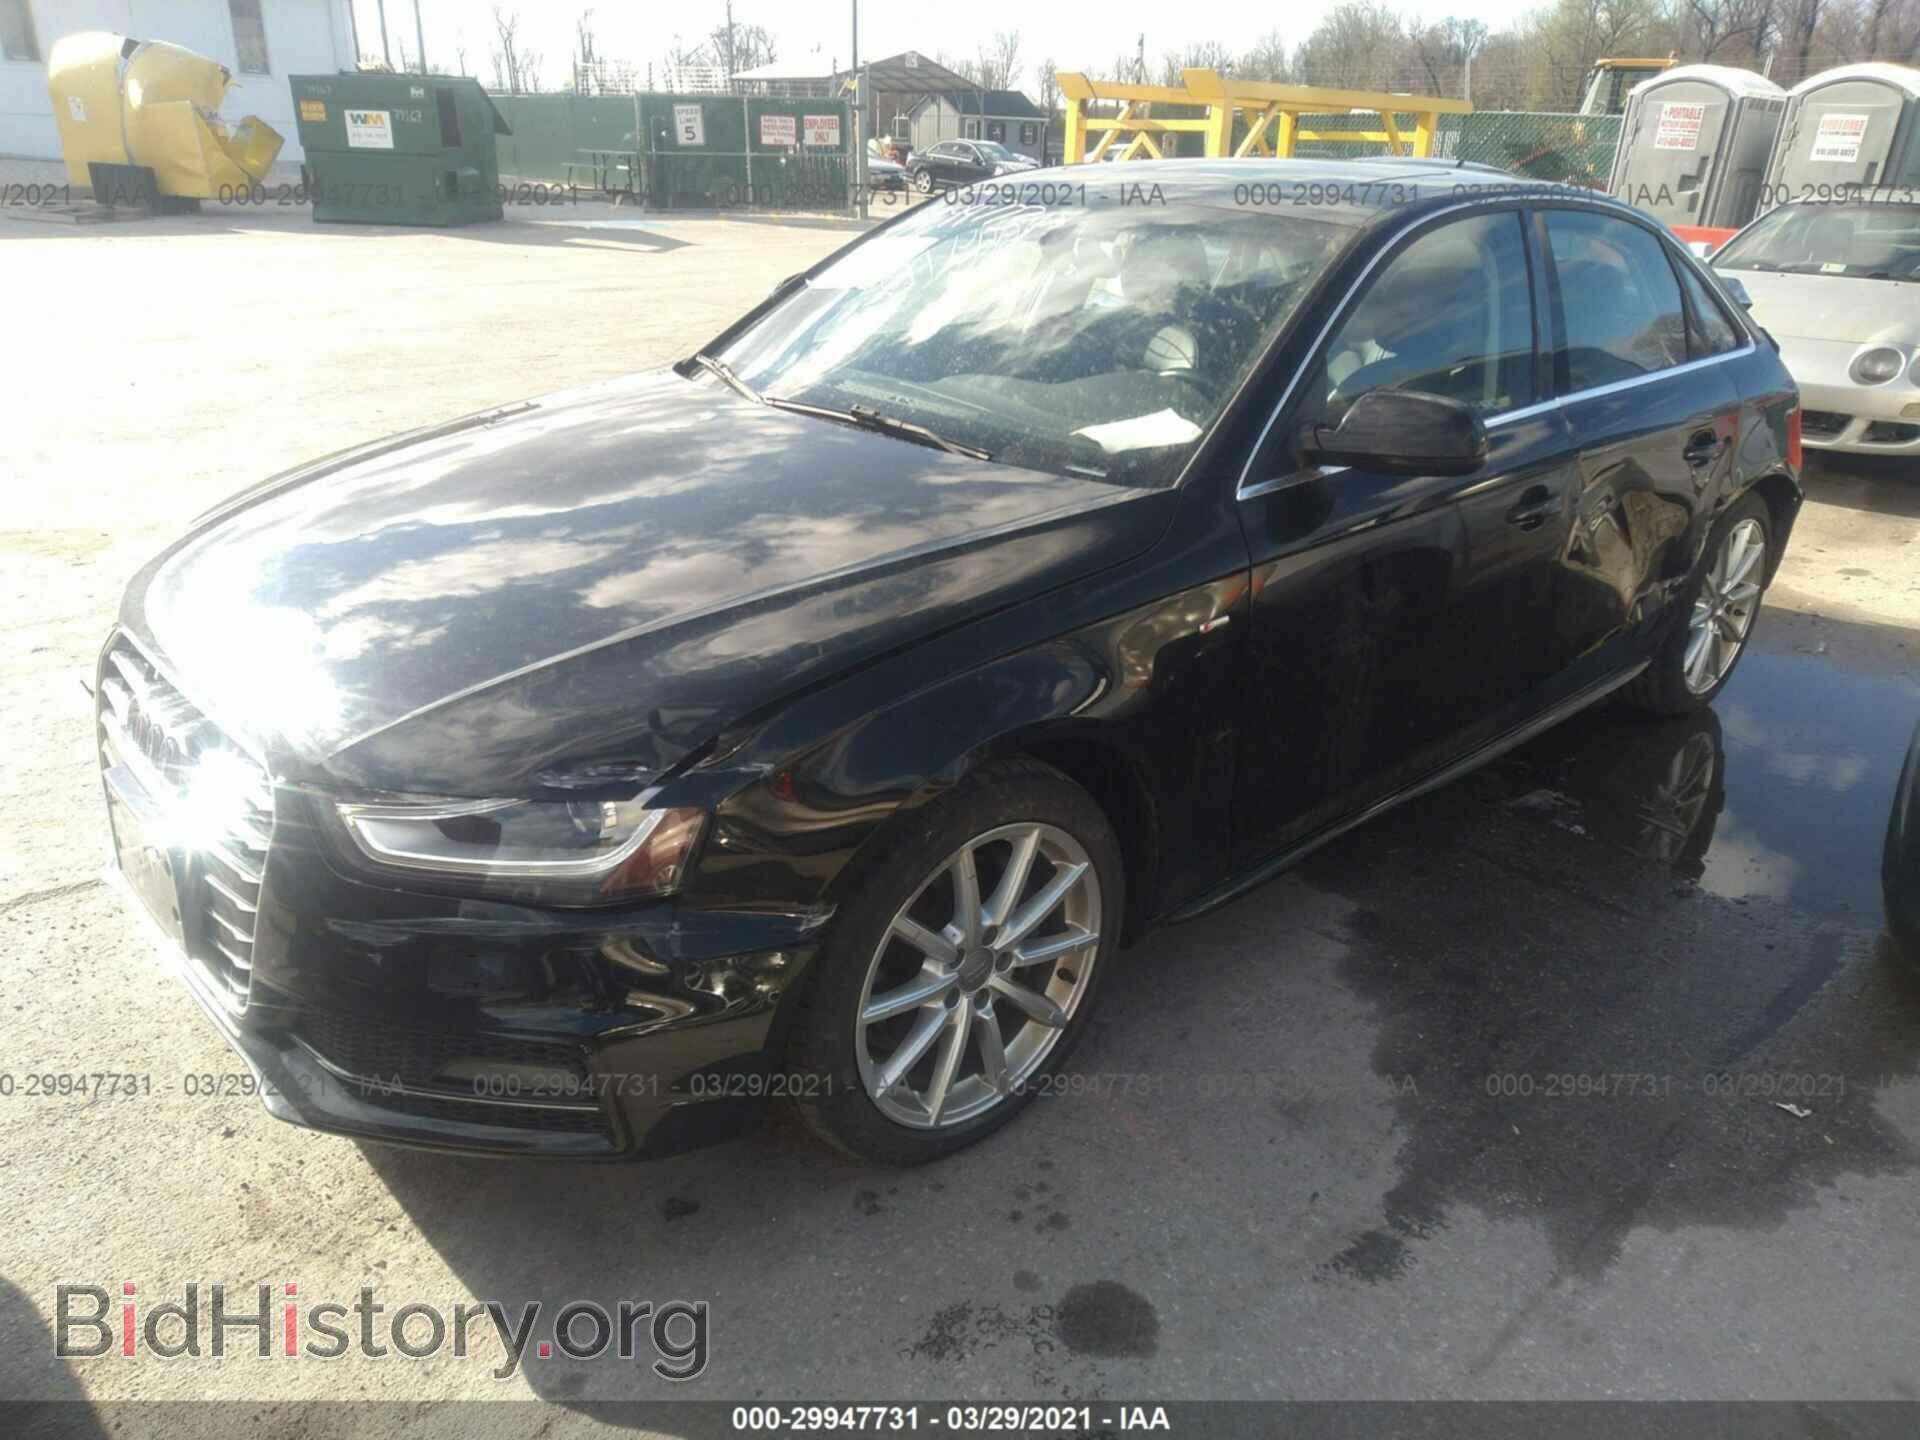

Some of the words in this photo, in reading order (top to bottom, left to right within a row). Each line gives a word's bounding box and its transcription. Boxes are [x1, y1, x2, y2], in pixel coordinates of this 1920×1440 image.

[349, 112, 385, 125] WM
[677, 108, 699, 116] SPEED
[684, 125, 697, 141] 5
